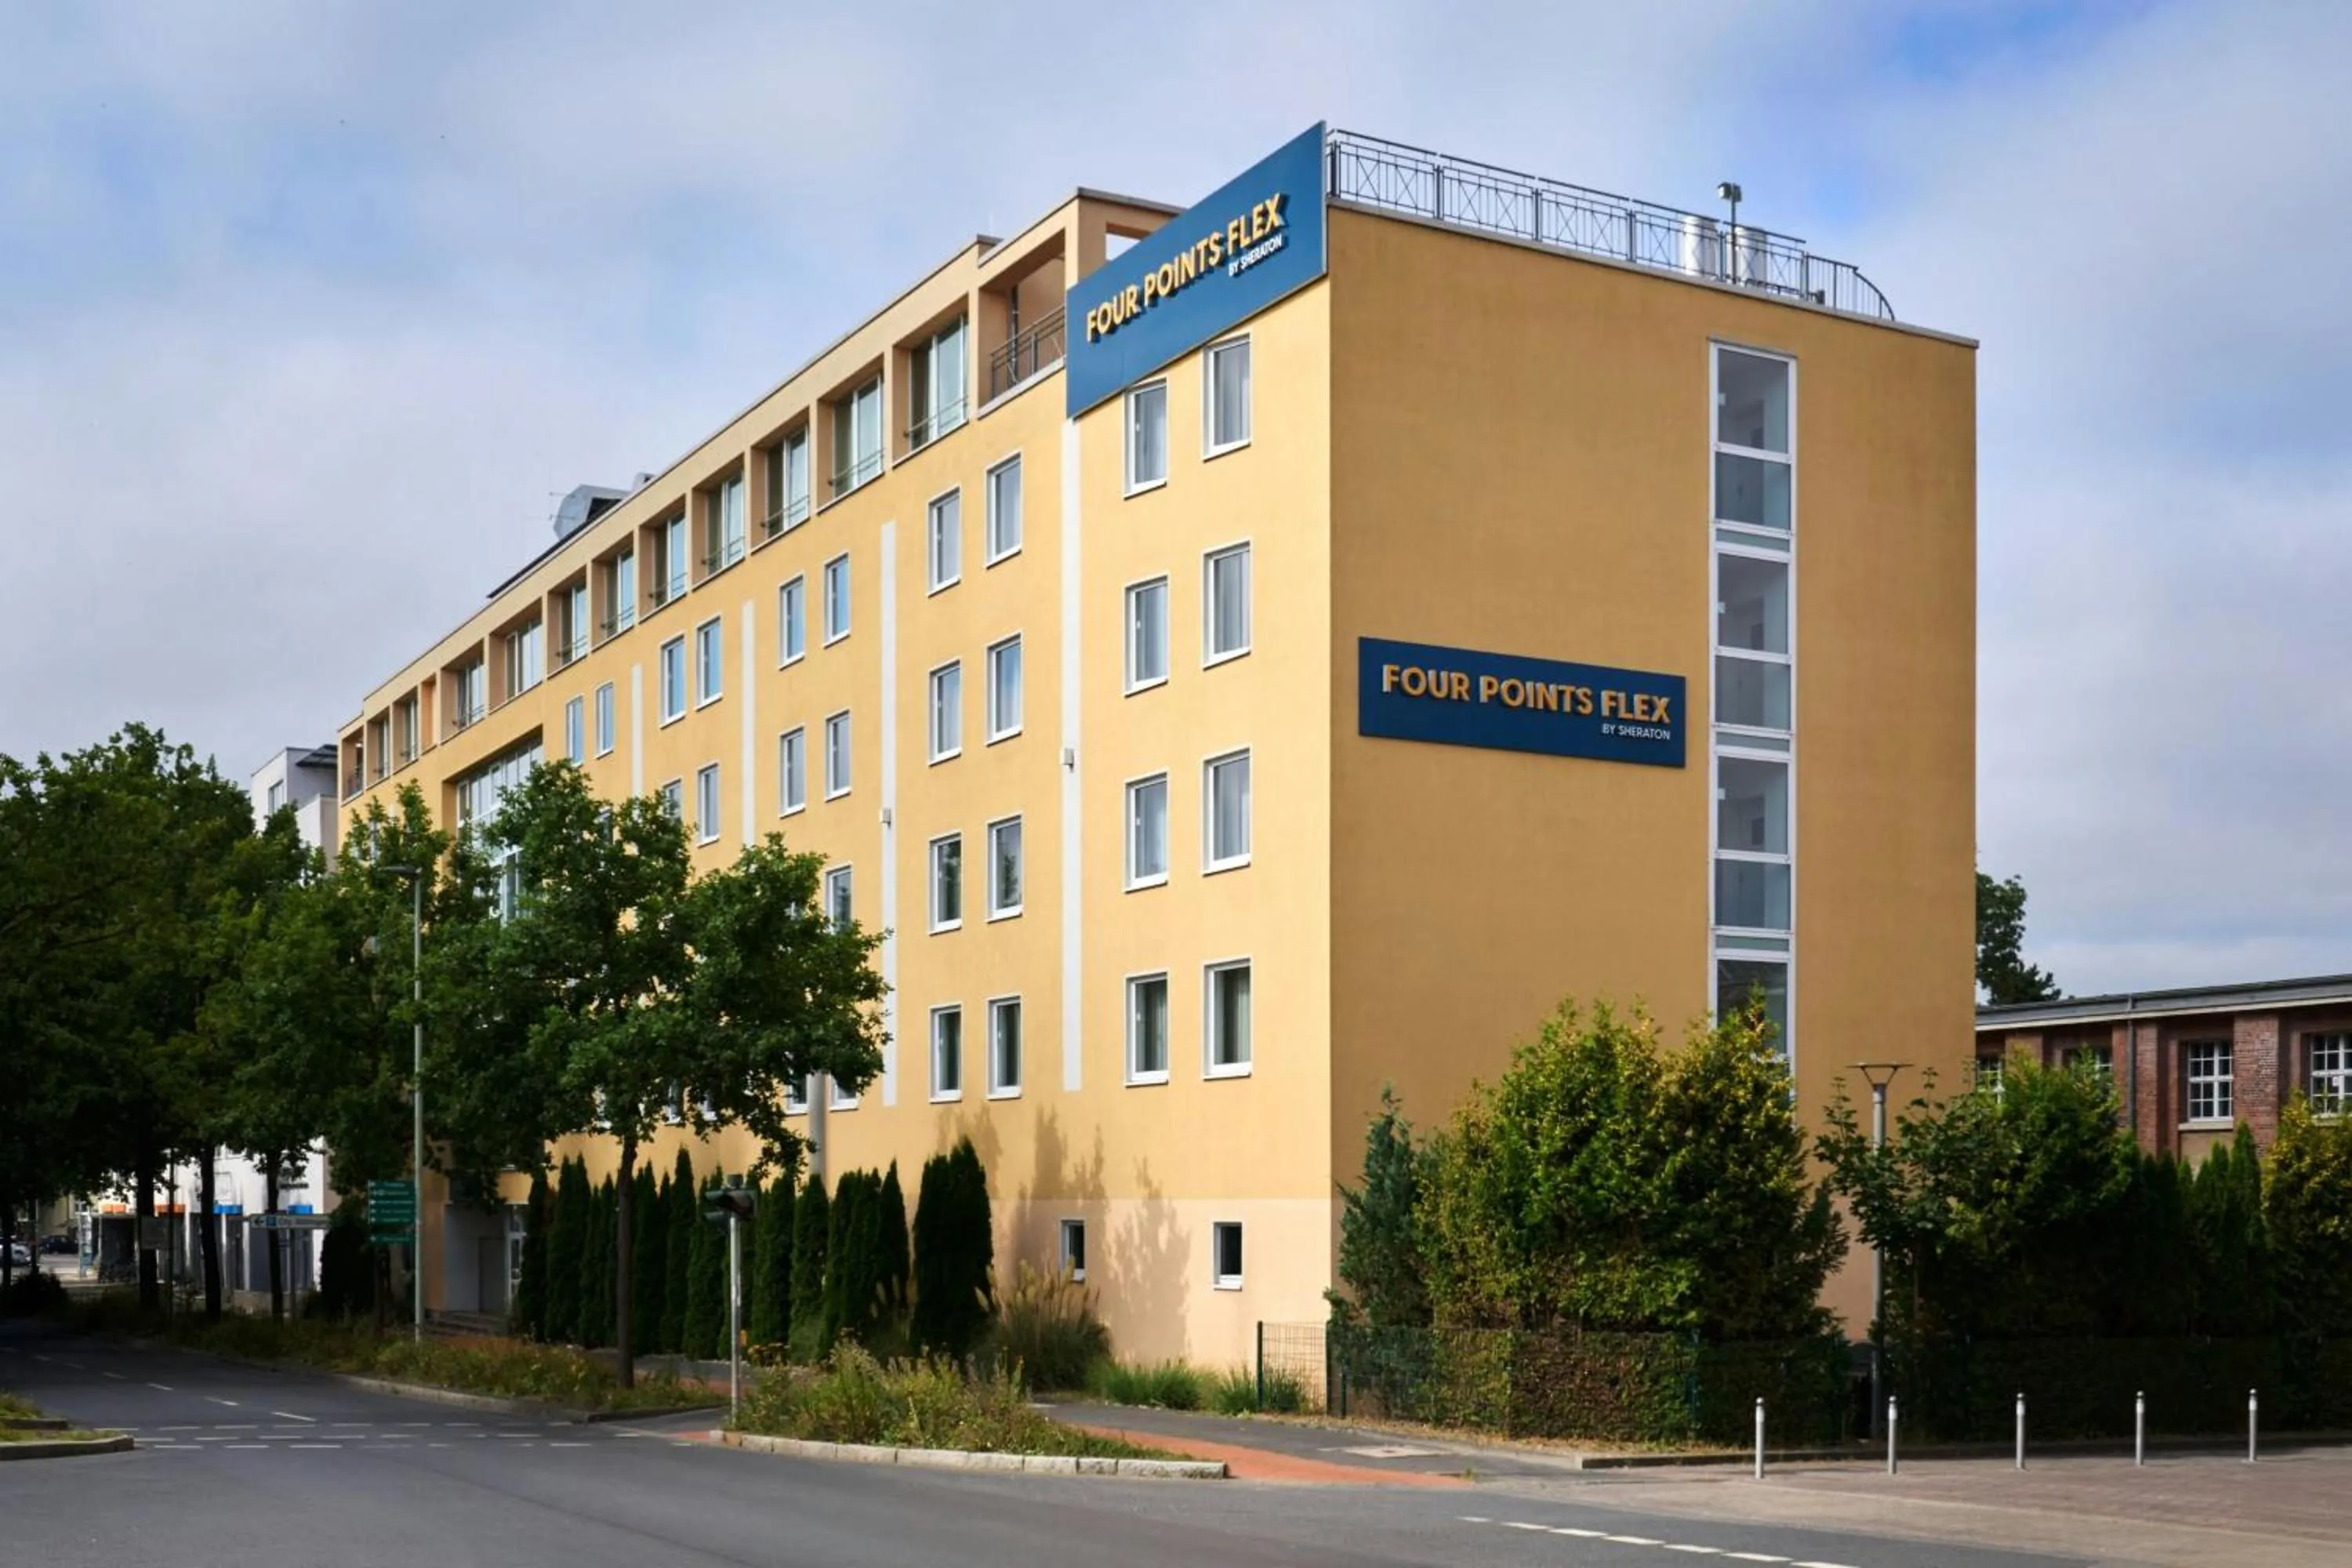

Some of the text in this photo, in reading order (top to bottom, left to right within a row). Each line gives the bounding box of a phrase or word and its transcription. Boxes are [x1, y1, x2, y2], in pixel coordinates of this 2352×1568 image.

[1087, 193, 1284, 342] FOUR POINTS FLEX
[1229, 233, 1283, 277] BY SHERATON
[1382, 664, 1671, 724] FOUR POINTS FLEX
[1602, 723, 1671, 740] BY SHERATON
